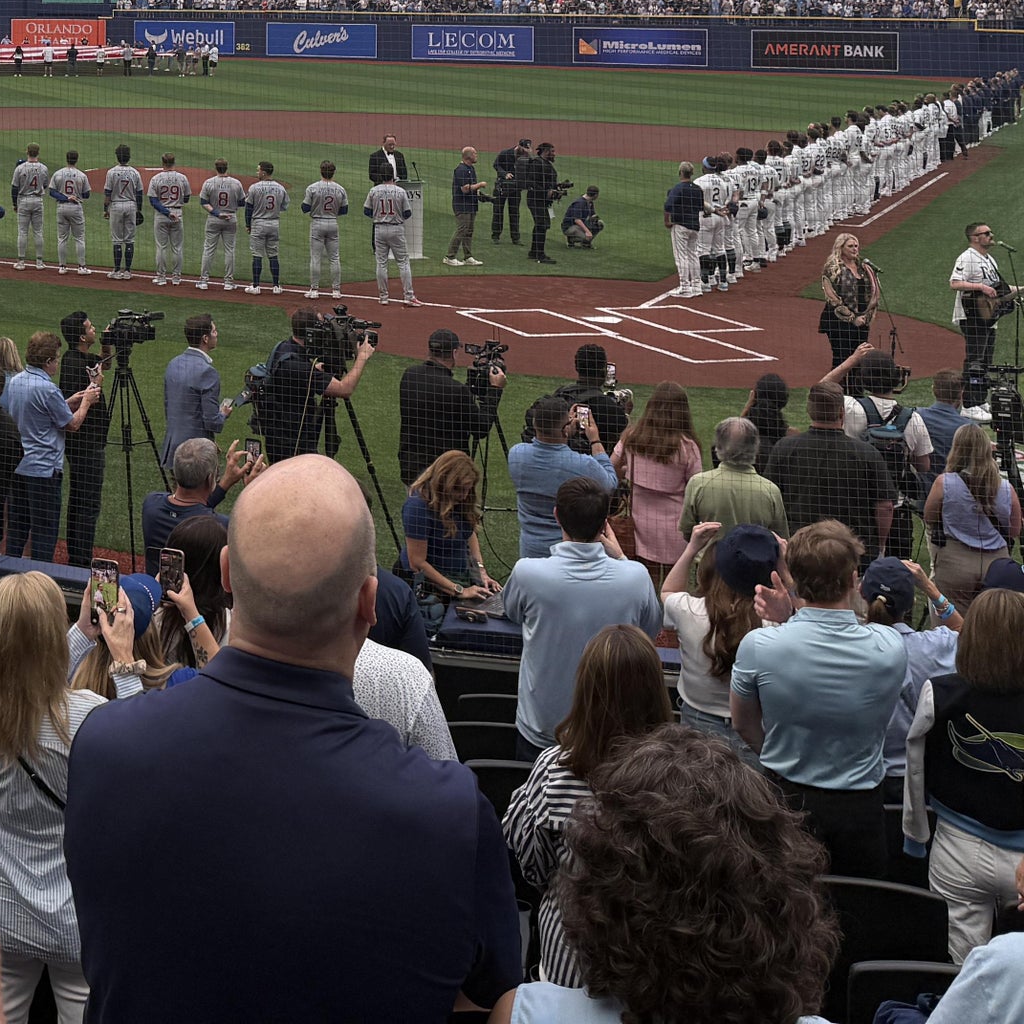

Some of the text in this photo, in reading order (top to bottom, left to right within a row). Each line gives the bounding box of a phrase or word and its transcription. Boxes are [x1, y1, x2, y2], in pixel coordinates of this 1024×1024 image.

[26, 22, 93, 35] ORLANDO
[34, 36, 89, 45] HAT
[171, 29, 224, 45] Webull
[293, 26, 349, 53] Culver's
[236, 43, 250, 51] 382
[603, 41, 702, 51] MicroLumen
[765, 43, 884, 57] AMERANT BANK
[29, 176, 38, 190] 4
[64, 180, 74, 194] 6
[119, 180, 129, 195] 7
[747, 177, 757, 191] 13
[159, 185, 180, 201] 29
[218, 192, 228, 206] 8
[406, 191, 421, 200] AYS
[712, 187, 720, 202] 2
[265, 195, 275, 210] 3
[323, 196, 334, 211] 2
[379, 199, 395, 216] 11
